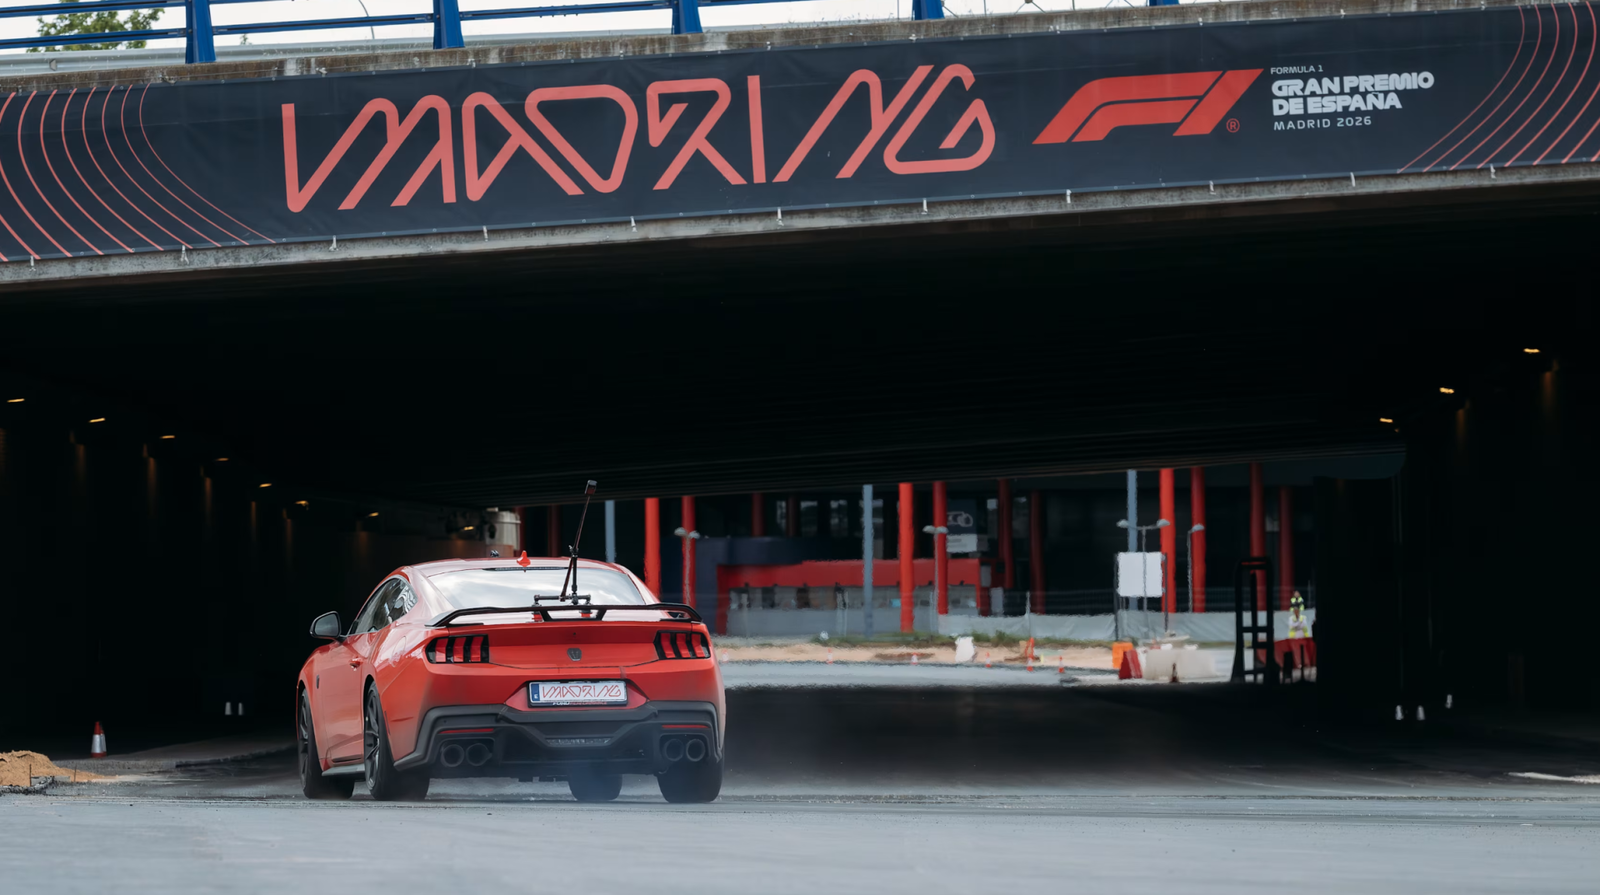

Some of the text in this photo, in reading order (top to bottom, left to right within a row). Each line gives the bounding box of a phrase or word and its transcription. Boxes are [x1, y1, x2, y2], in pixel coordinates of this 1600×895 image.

[1270, 64, 1324, 75] FORMULA 1
[1271, 71, 1435, 97] GRAN PREMIO
[1272, 91, 1403, 116] DE ESPAÑA
[1273, 116, 1372, 131] MADRID 2026
